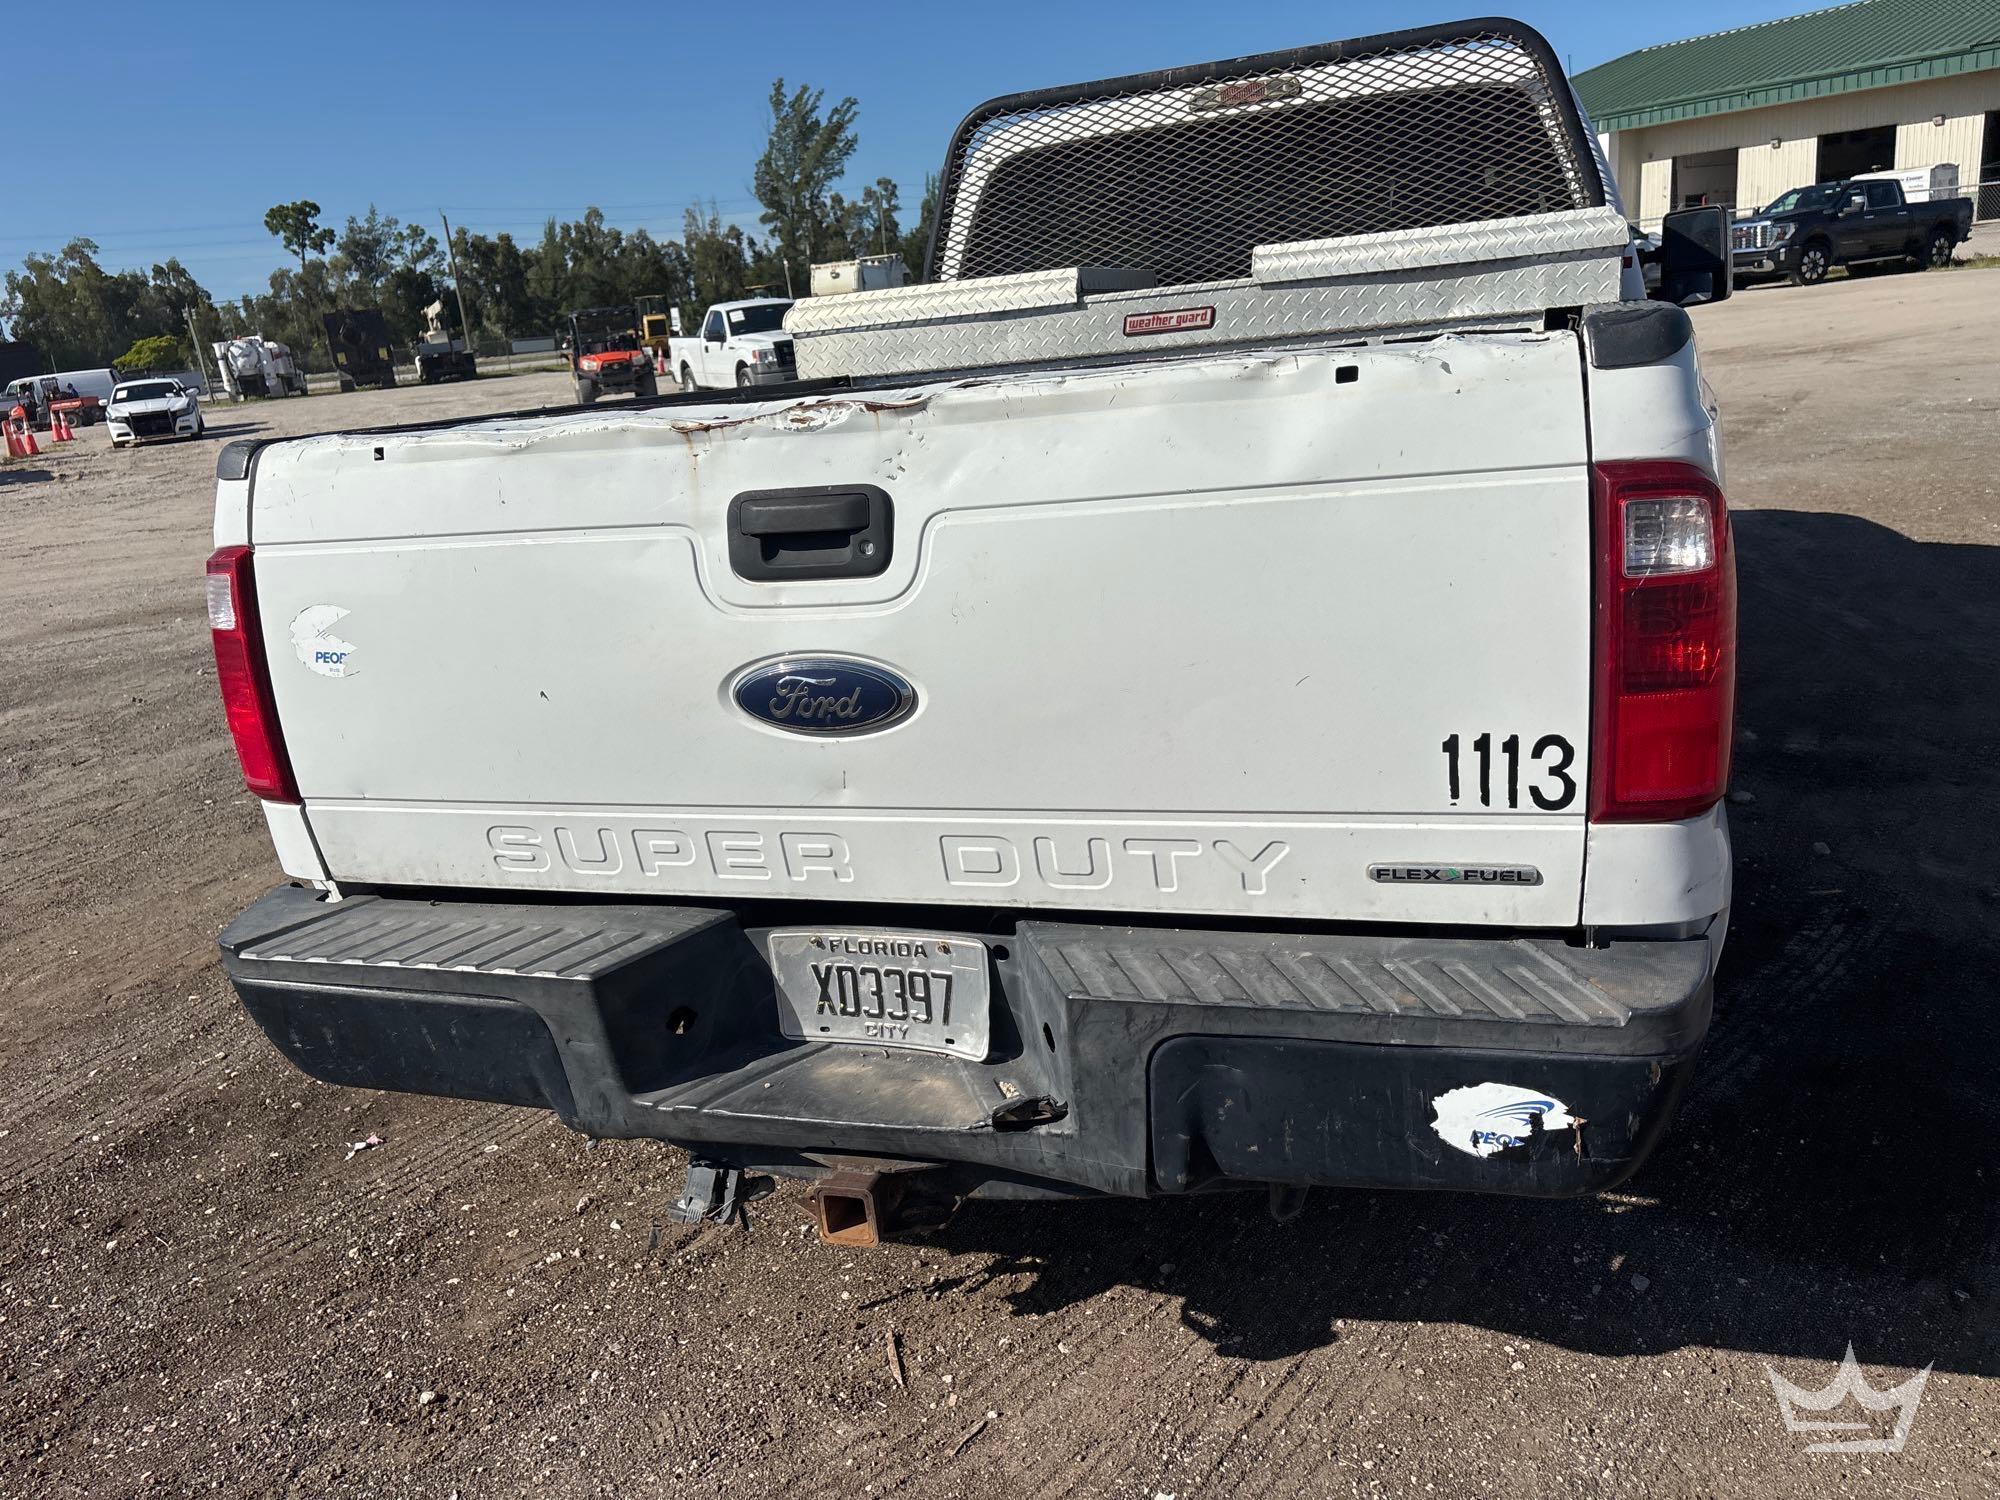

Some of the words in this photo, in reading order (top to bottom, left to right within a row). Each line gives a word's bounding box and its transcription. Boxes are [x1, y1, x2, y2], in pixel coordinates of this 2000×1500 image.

[1128, 315, 1174, 329] weather
[1176, 310, 1208, 326] guard
[768, 675, 863, 719] Ford
[1442, 732, 1577, 811] 1113
[486, 825, 854, 882] SUPER
[939, 835, 1290, 895] DUTY
[1376, 868, 1441, 880] FLEX
[1463, 869, 1531, 882] FUEL
[829, 937, 928, 959] FLORIDA
[863, 1021, 910, 1040] CITY
